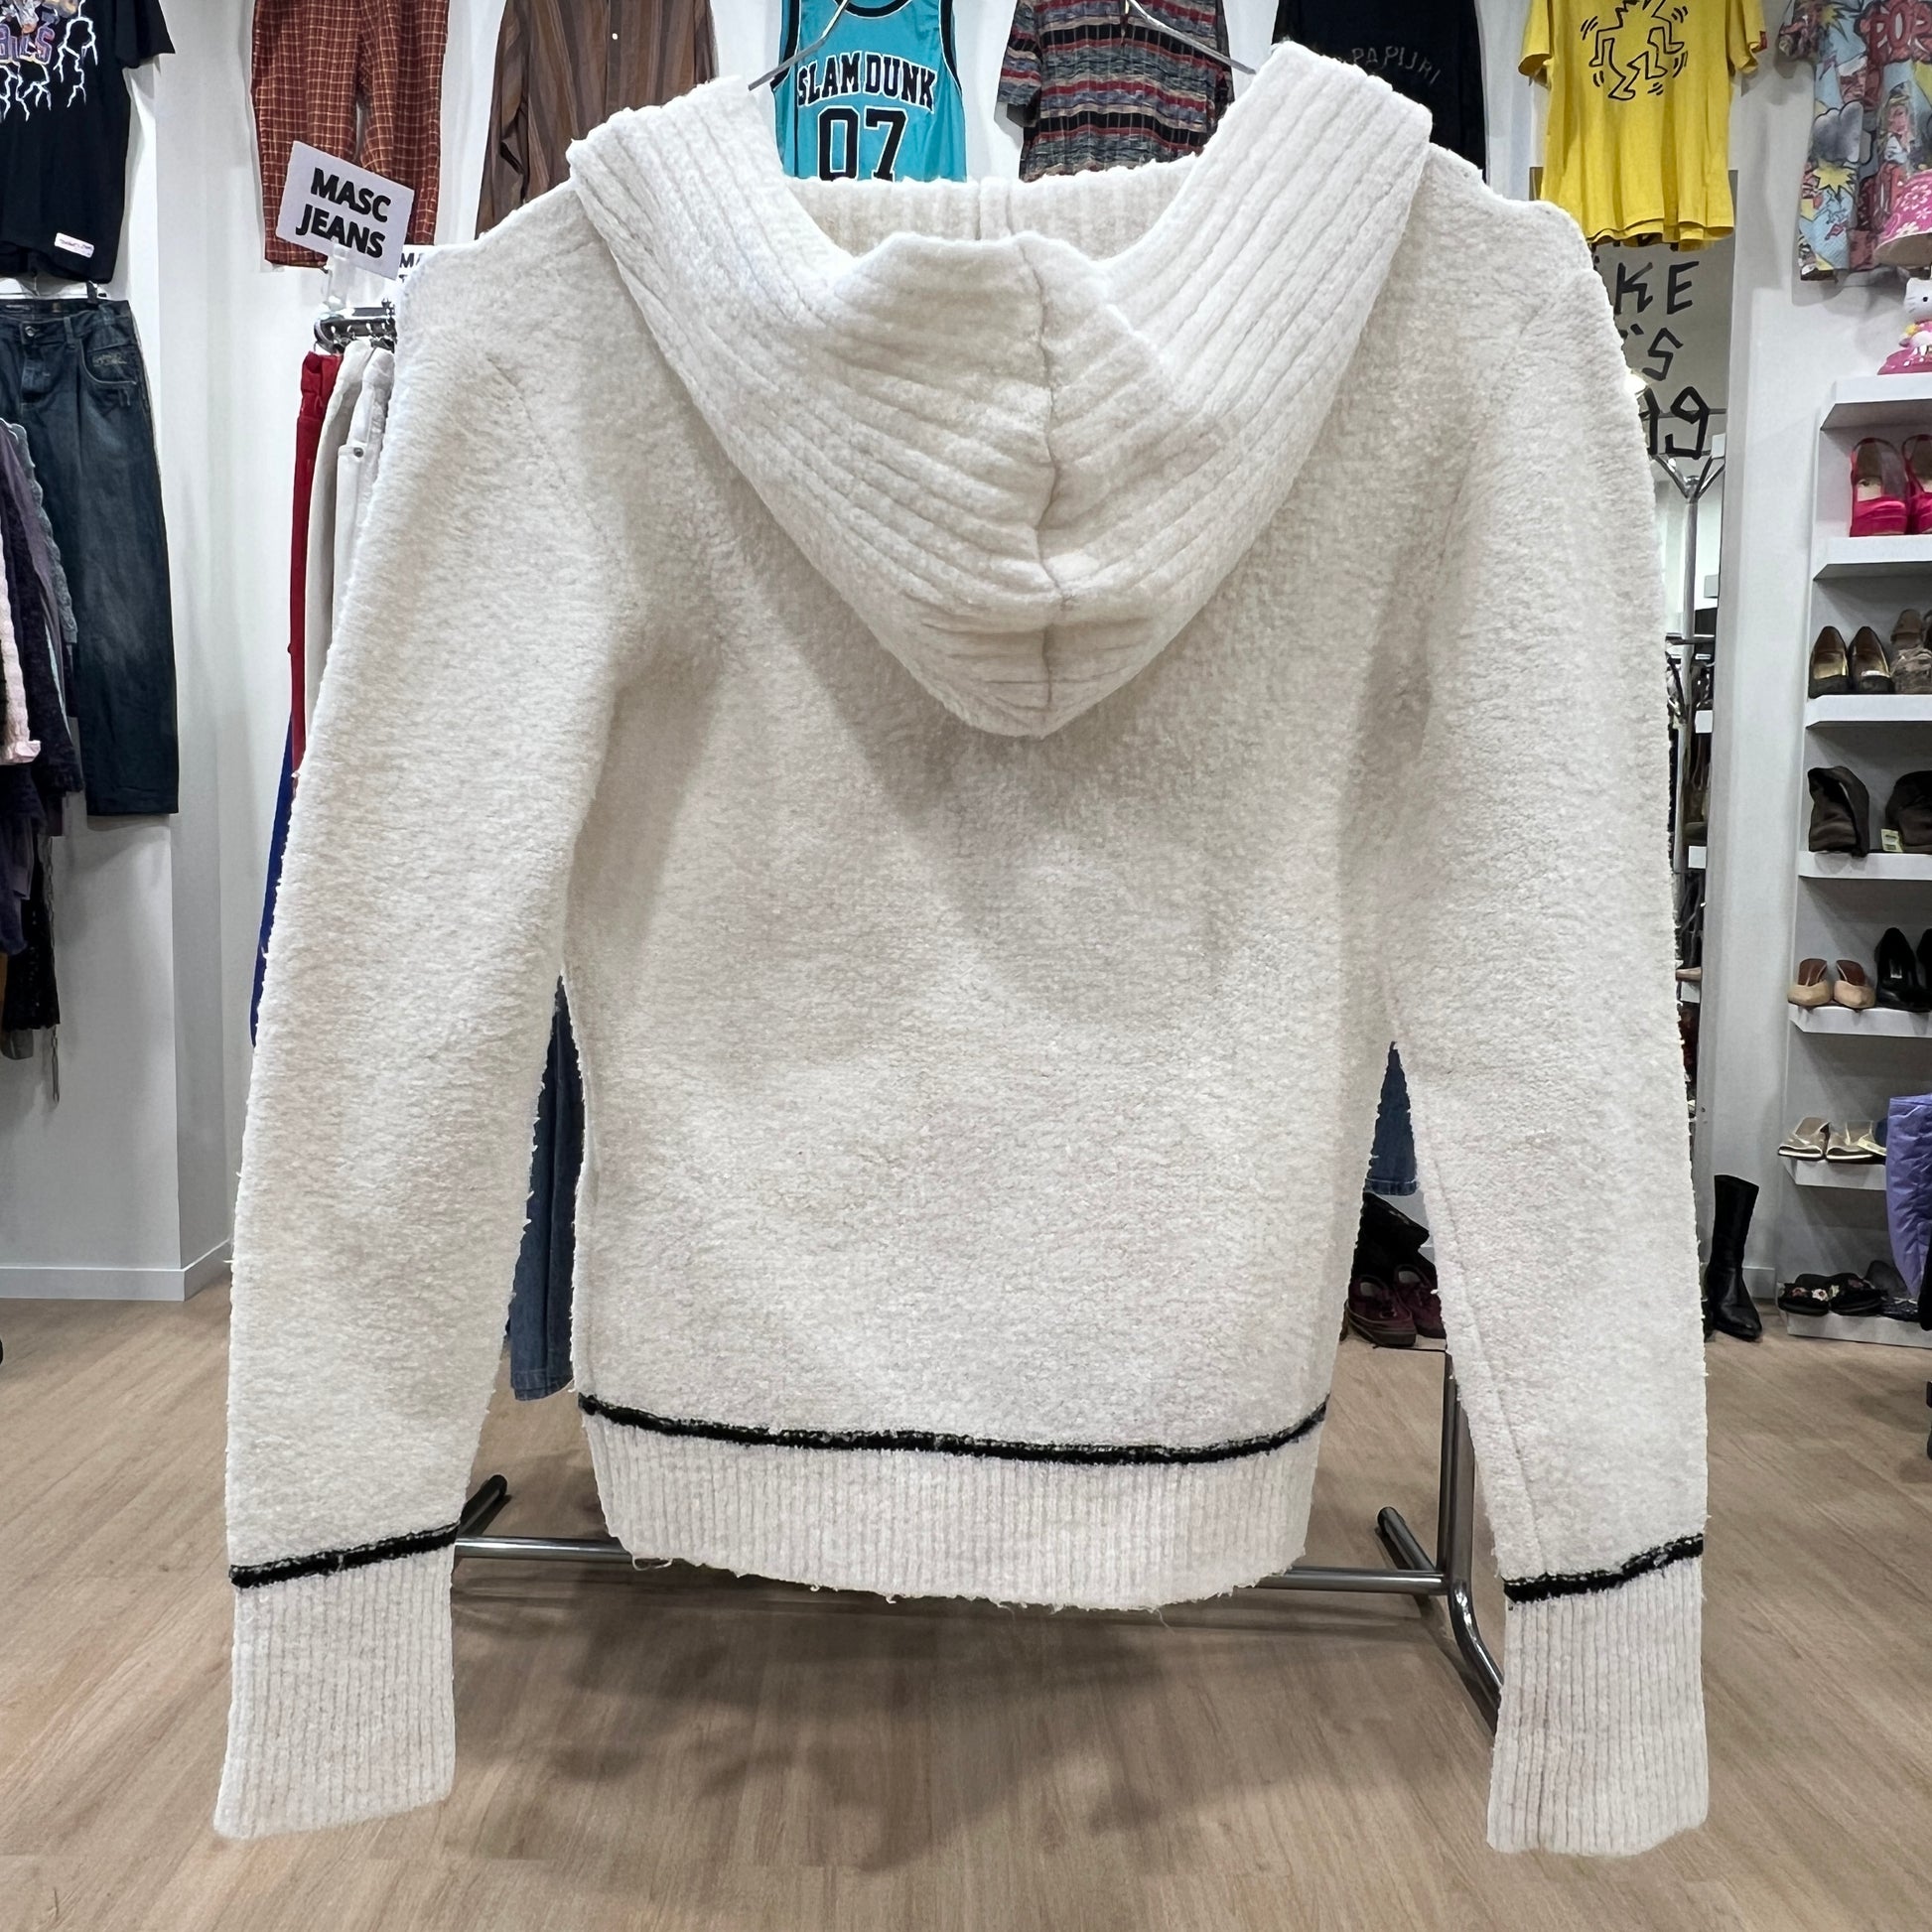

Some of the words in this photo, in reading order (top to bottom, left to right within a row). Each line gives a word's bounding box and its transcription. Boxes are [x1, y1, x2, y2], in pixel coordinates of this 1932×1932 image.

[797, 51, 862, 107] SLAM
[863, 52, 937, 114] DUNK
[818, 105, 907, 182] 07
[310, 167, 391, 223] MASC
[295, 204, 386, 258] JEANS
[1612, 260, 1700, 315] KE
